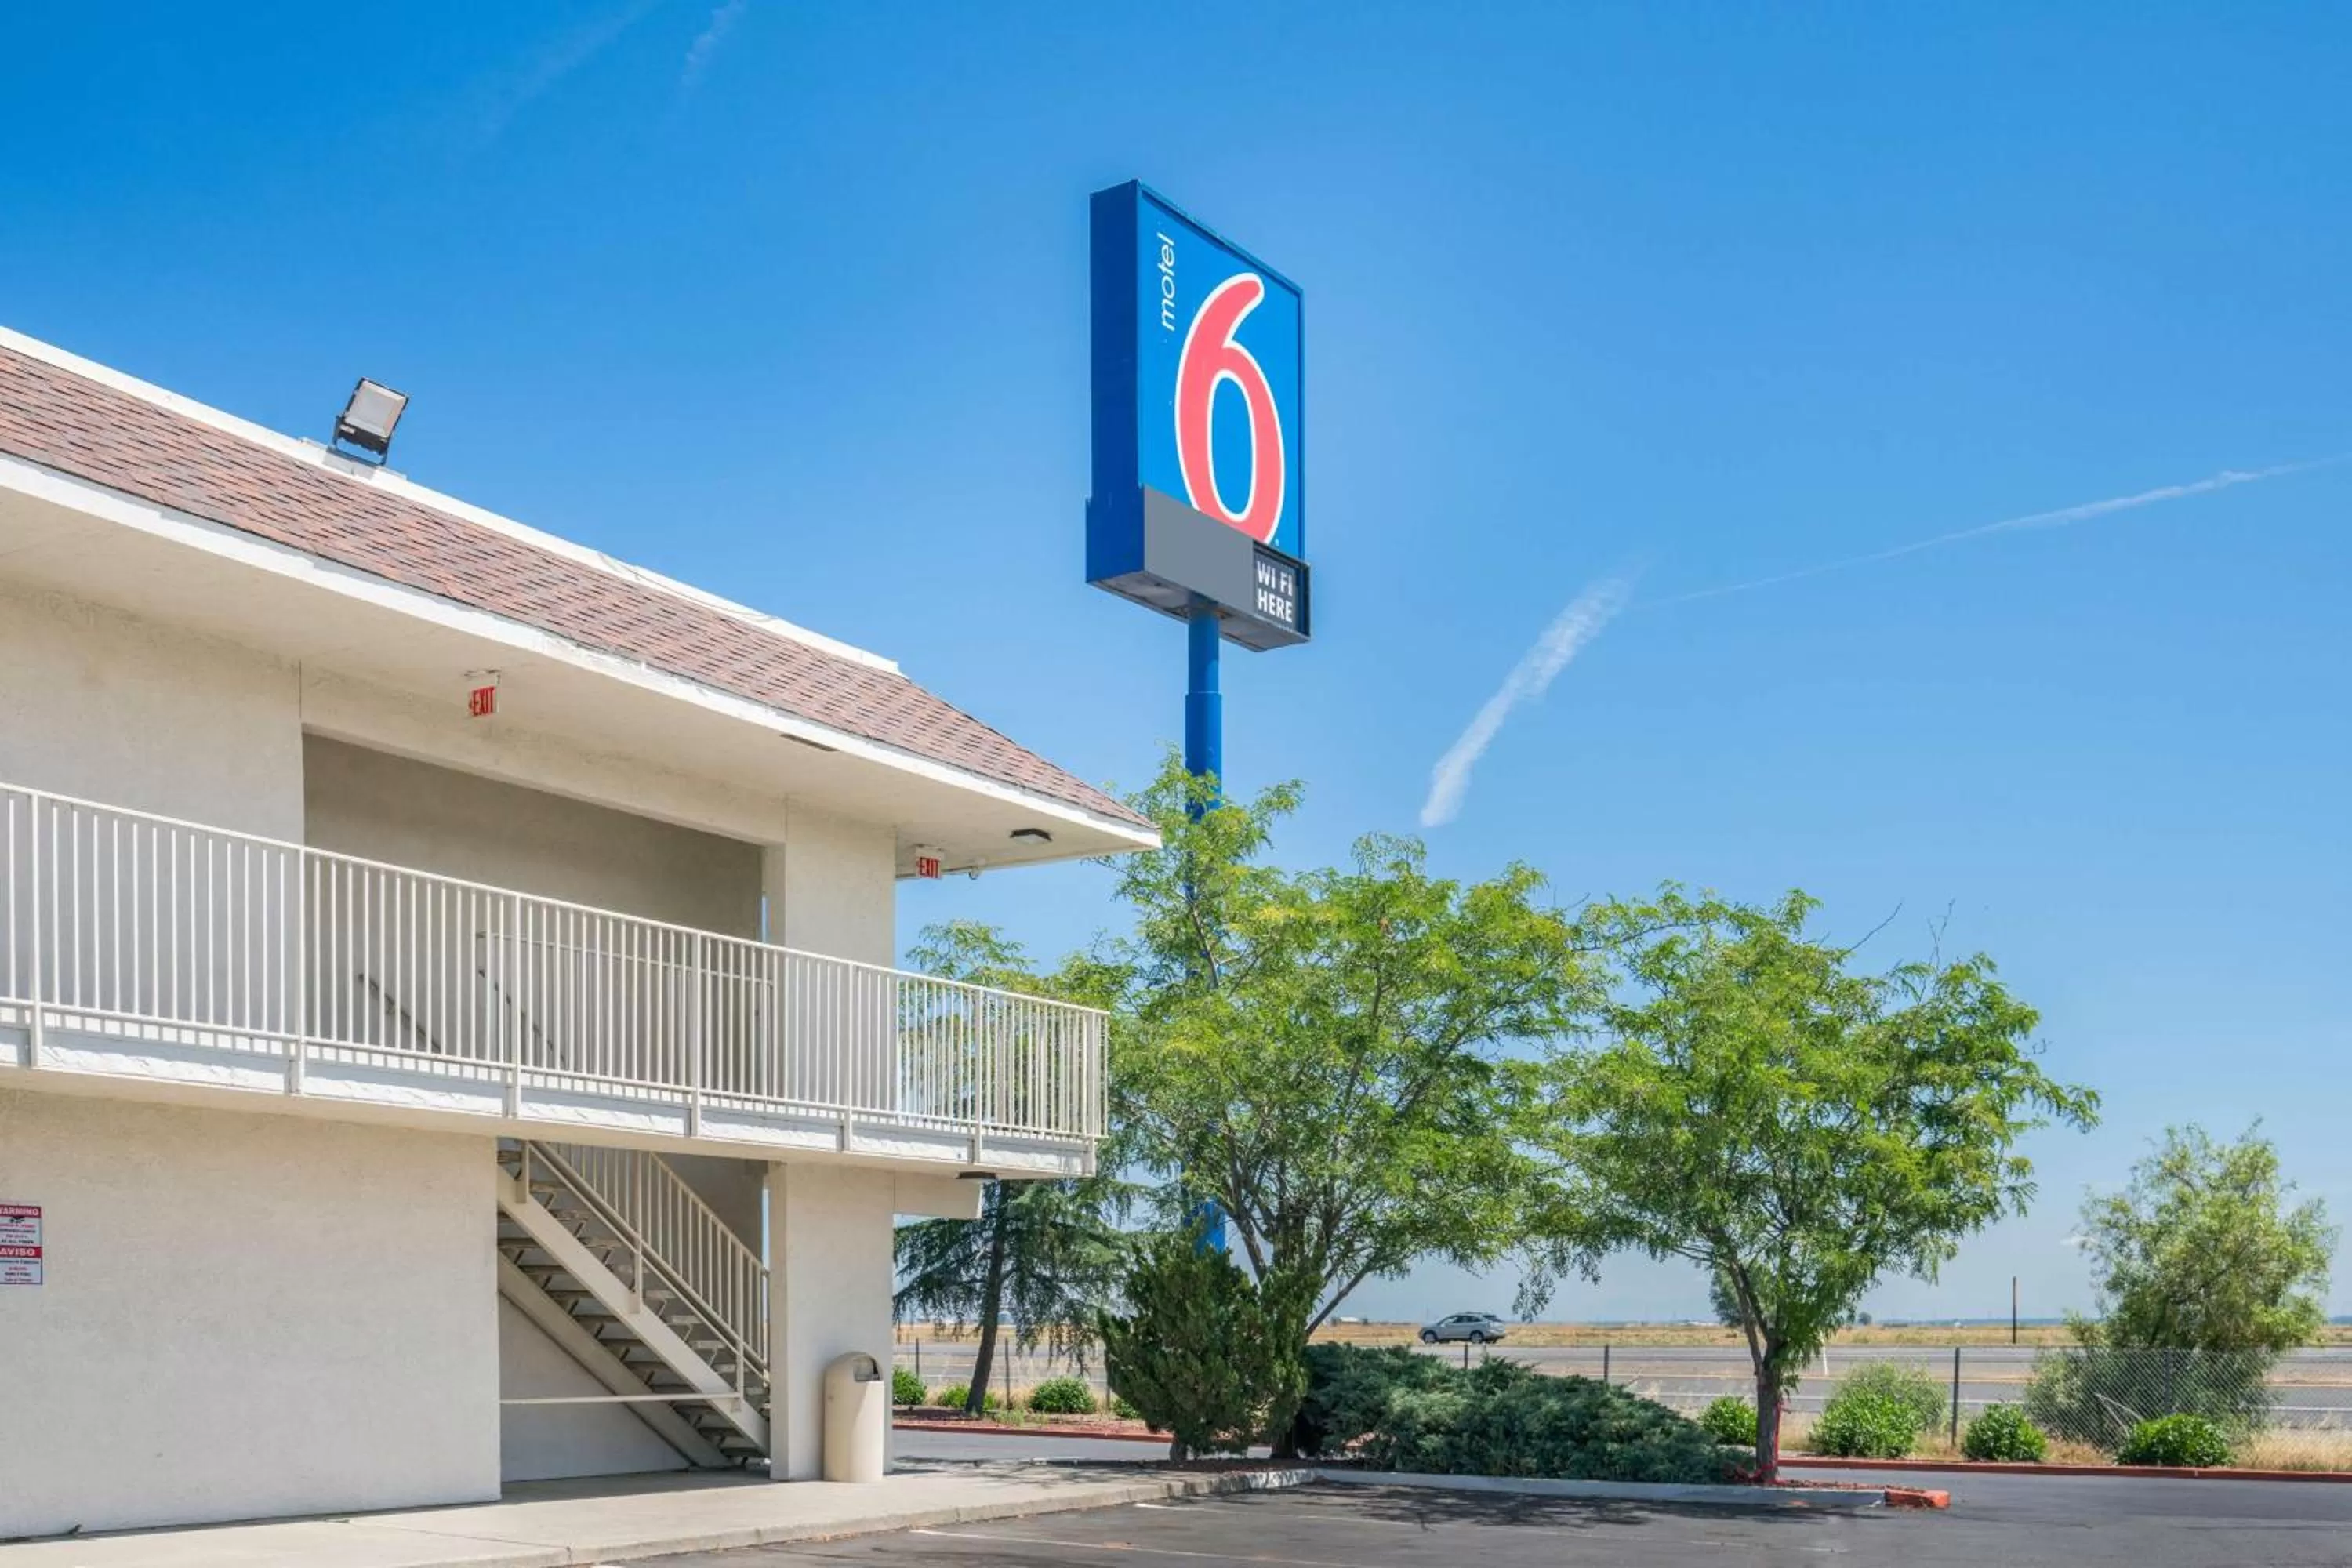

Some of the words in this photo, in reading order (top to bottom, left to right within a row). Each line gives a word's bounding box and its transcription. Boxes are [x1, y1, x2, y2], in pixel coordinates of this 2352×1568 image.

[1156, 232, 1175, 331] motel
[1174, 272, 1285, 544] 6
[1257, 561, 1276, 590] WI
[1279, 572, 1293, 597] FI
[1257, 588, 1293, 623] HERE
[473, 686, 495, 717] EXIT
[919, 856, 941, 879] EXIT
[0, 1247, 36, 1256] AVISO
